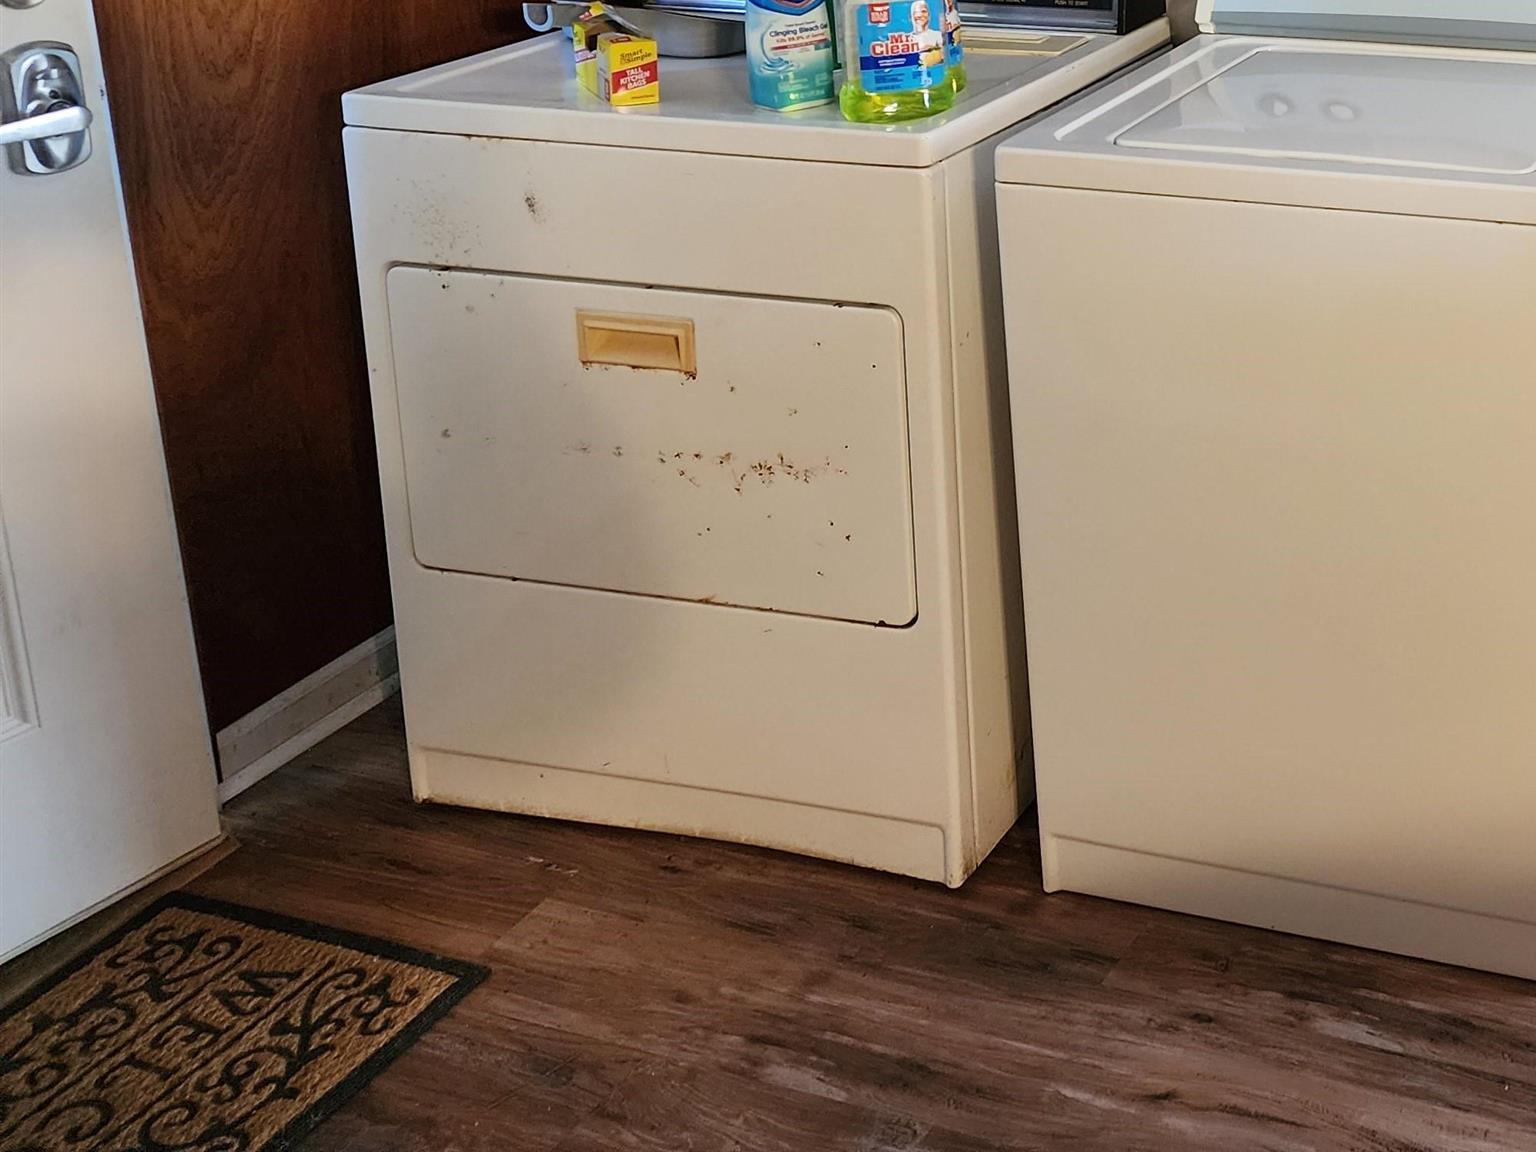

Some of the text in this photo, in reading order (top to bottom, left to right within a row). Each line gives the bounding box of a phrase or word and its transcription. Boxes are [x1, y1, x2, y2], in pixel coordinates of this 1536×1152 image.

[871, 42, 920, 57] Clean
[619, 70, 651, 86] KITCHEN
[626, 67, 643, 77] TALL
[627, 79, 647, 90] BAGS
